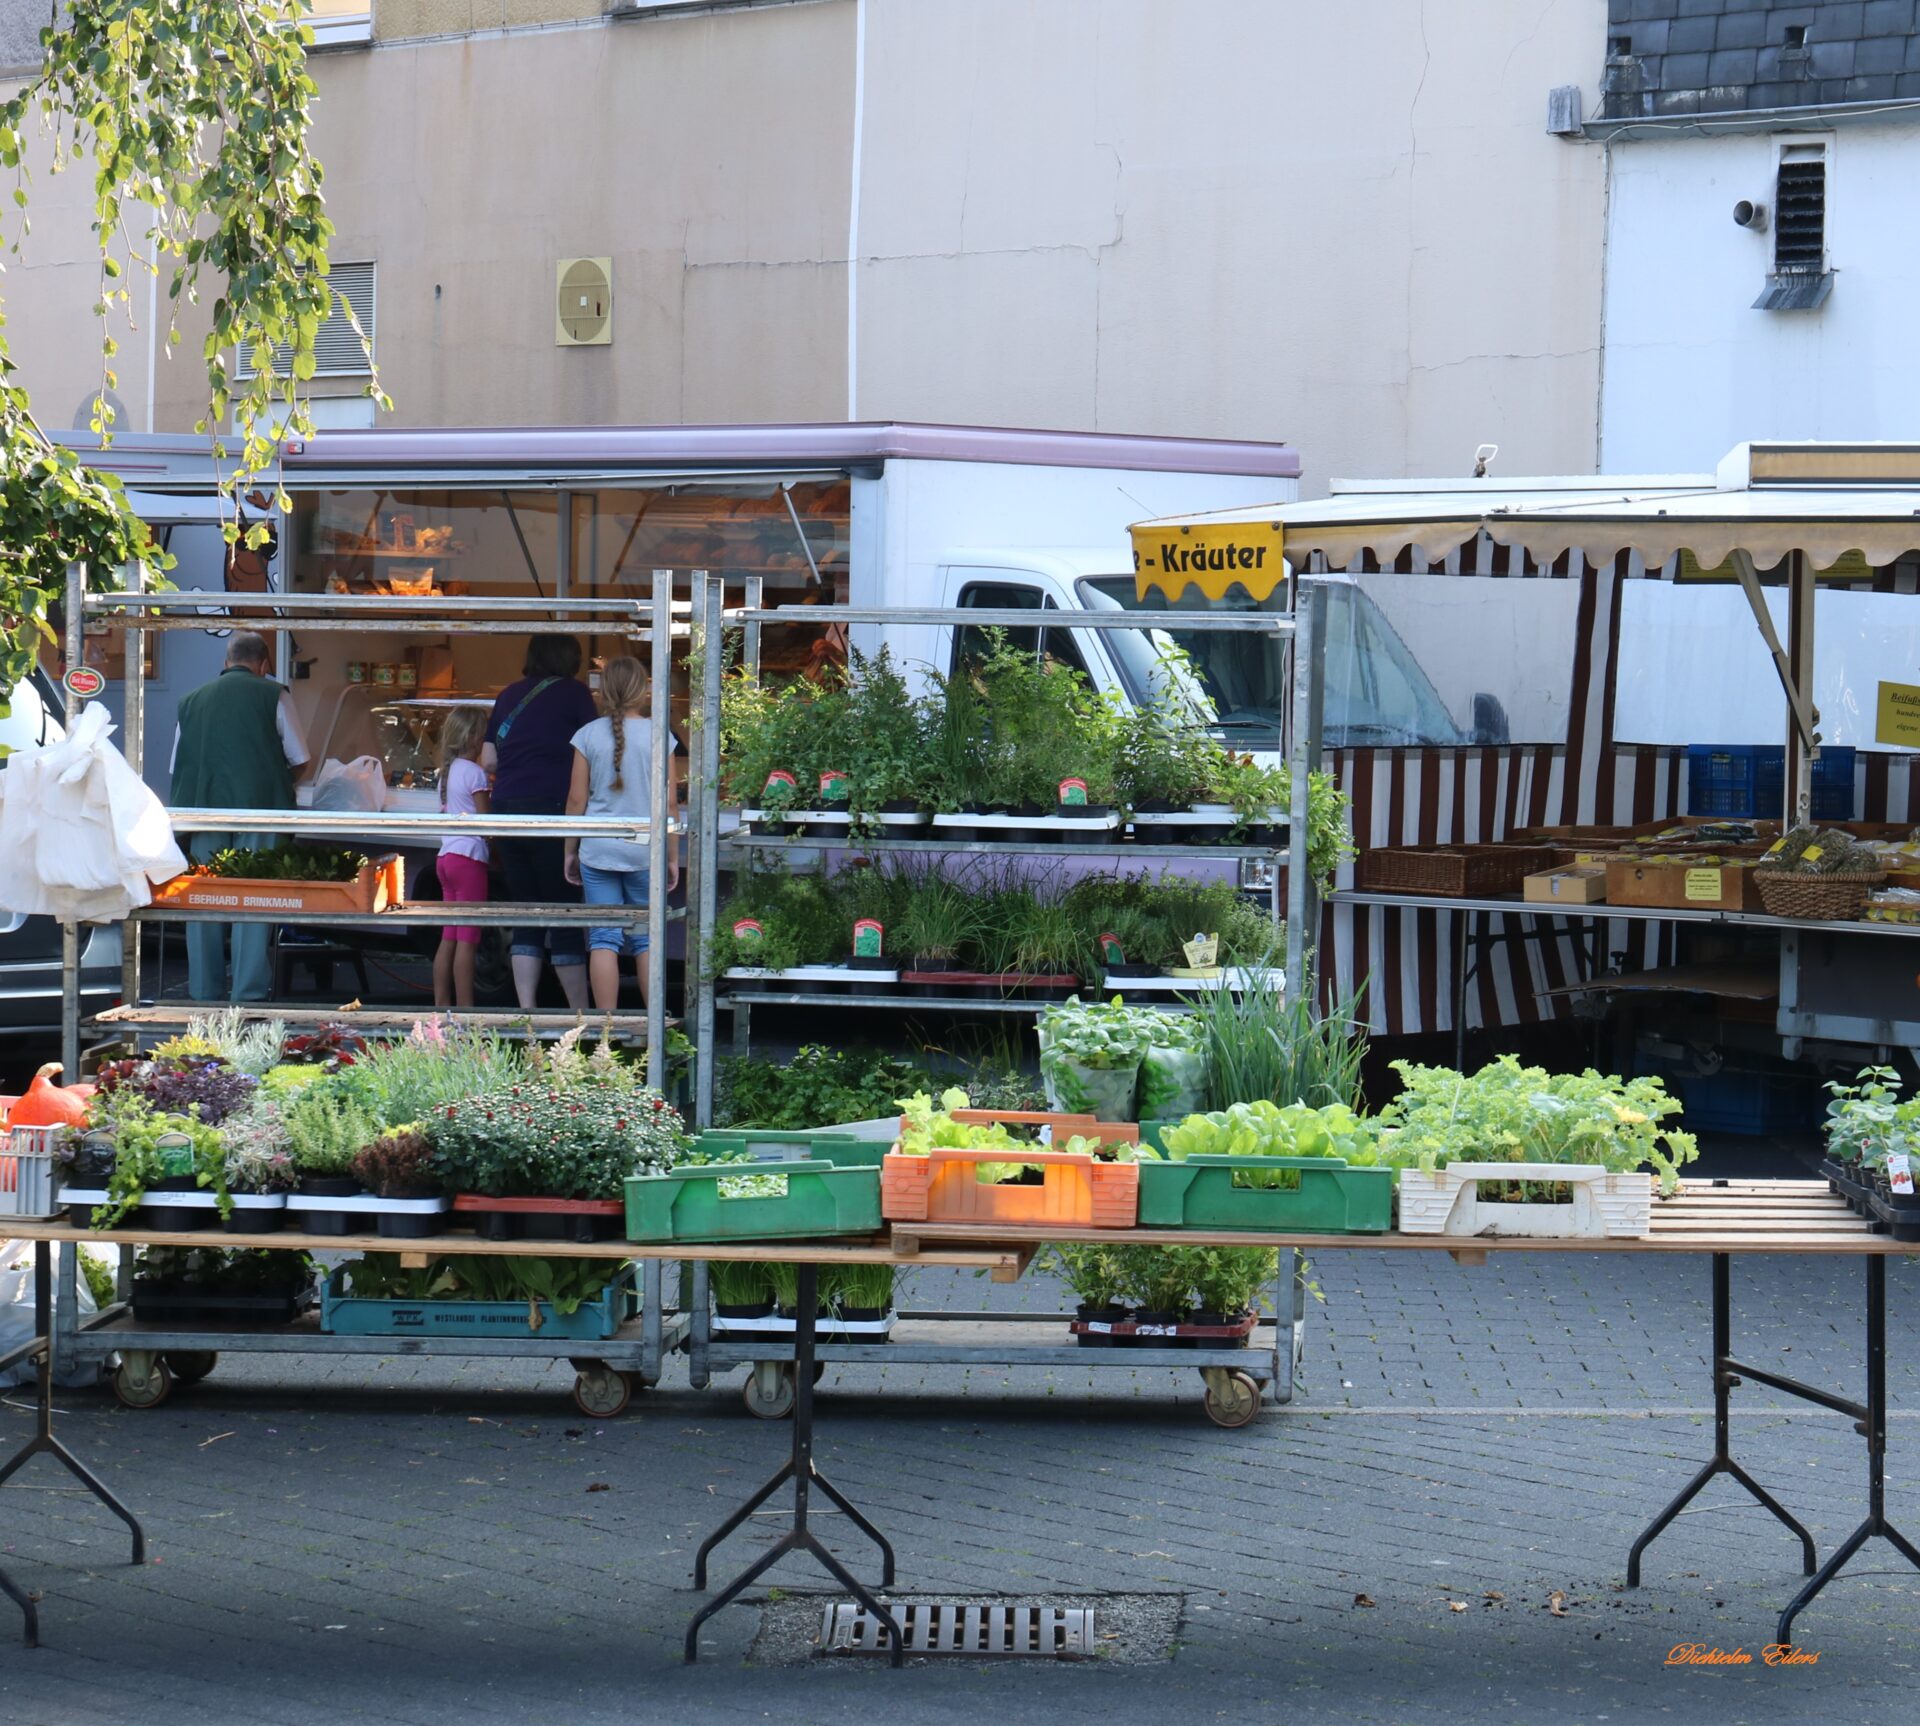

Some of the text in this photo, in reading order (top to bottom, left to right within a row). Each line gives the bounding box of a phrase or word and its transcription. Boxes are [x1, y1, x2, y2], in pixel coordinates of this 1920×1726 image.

[1161, 543, 1267, 572] Kräuter
[188, 894, 238, 906] EBERHARD
[243, 896, 303, 909] BRINKMANN
